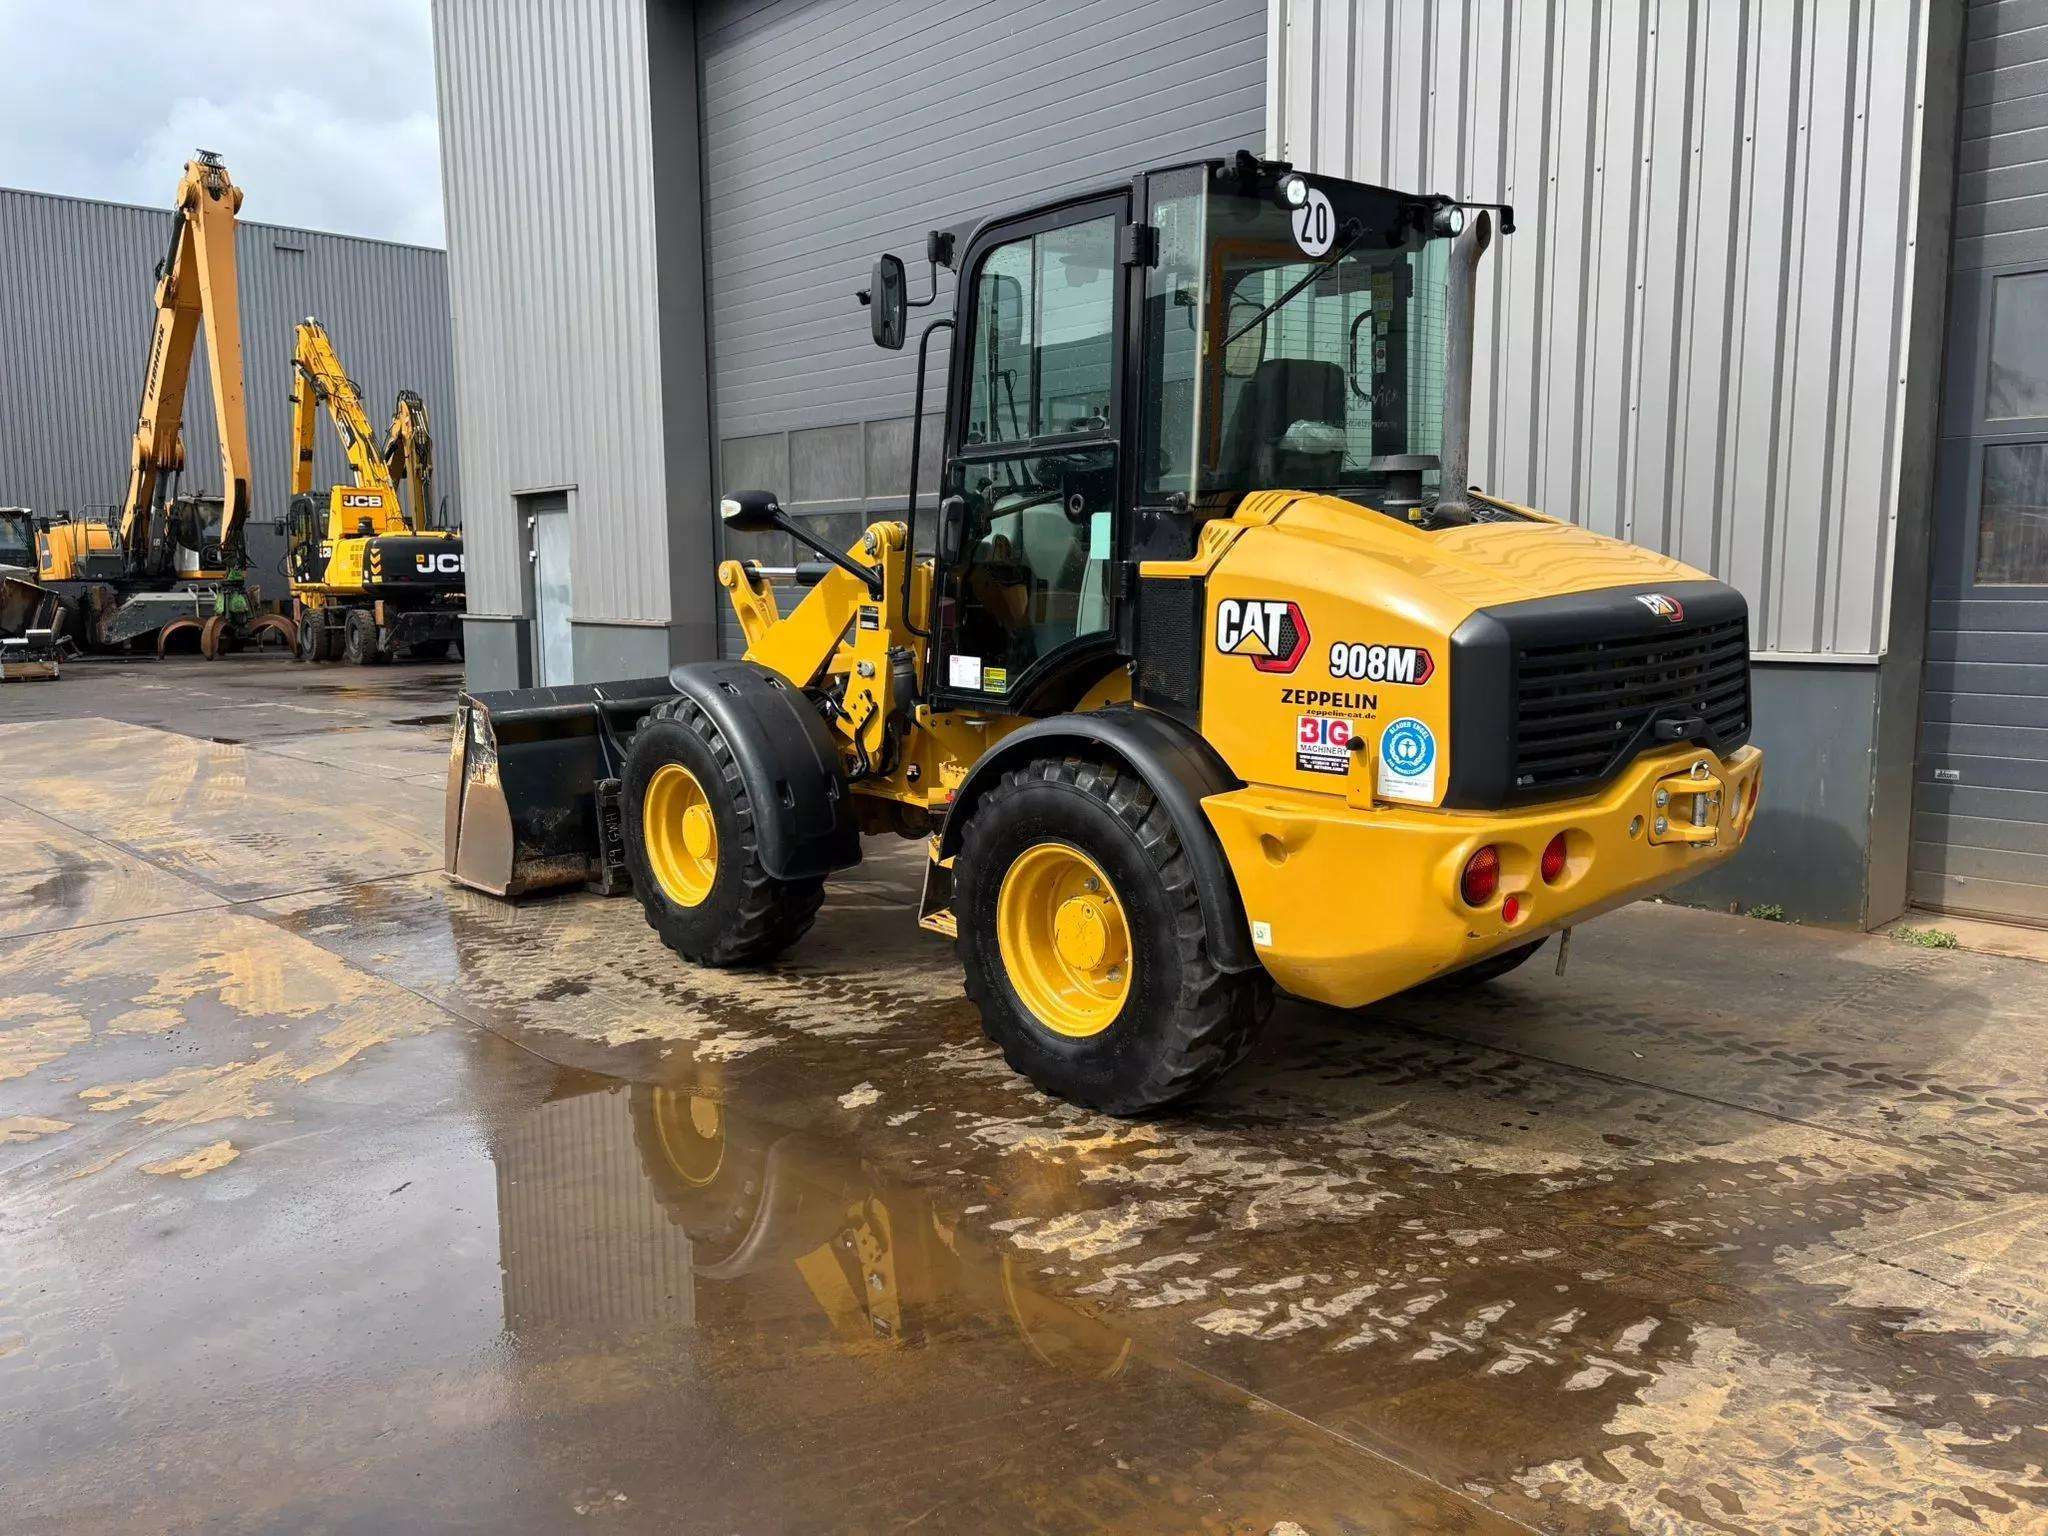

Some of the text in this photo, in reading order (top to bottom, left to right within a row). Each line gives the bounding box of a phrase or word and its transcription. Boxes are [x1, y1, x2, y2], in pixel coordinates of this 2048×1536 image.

[1301, 201, 1327, 244] 20
[343, 495, 382, 507] JCB
[415, 554, 464, 573] JC
[1217, 600, 1288, 656] CAT
[1330, 642, 1417, 683] 908M
[1281, 688, 1378, 710] ZEPPELIN
[1300, 744, 1348, 756] MACHINERY
